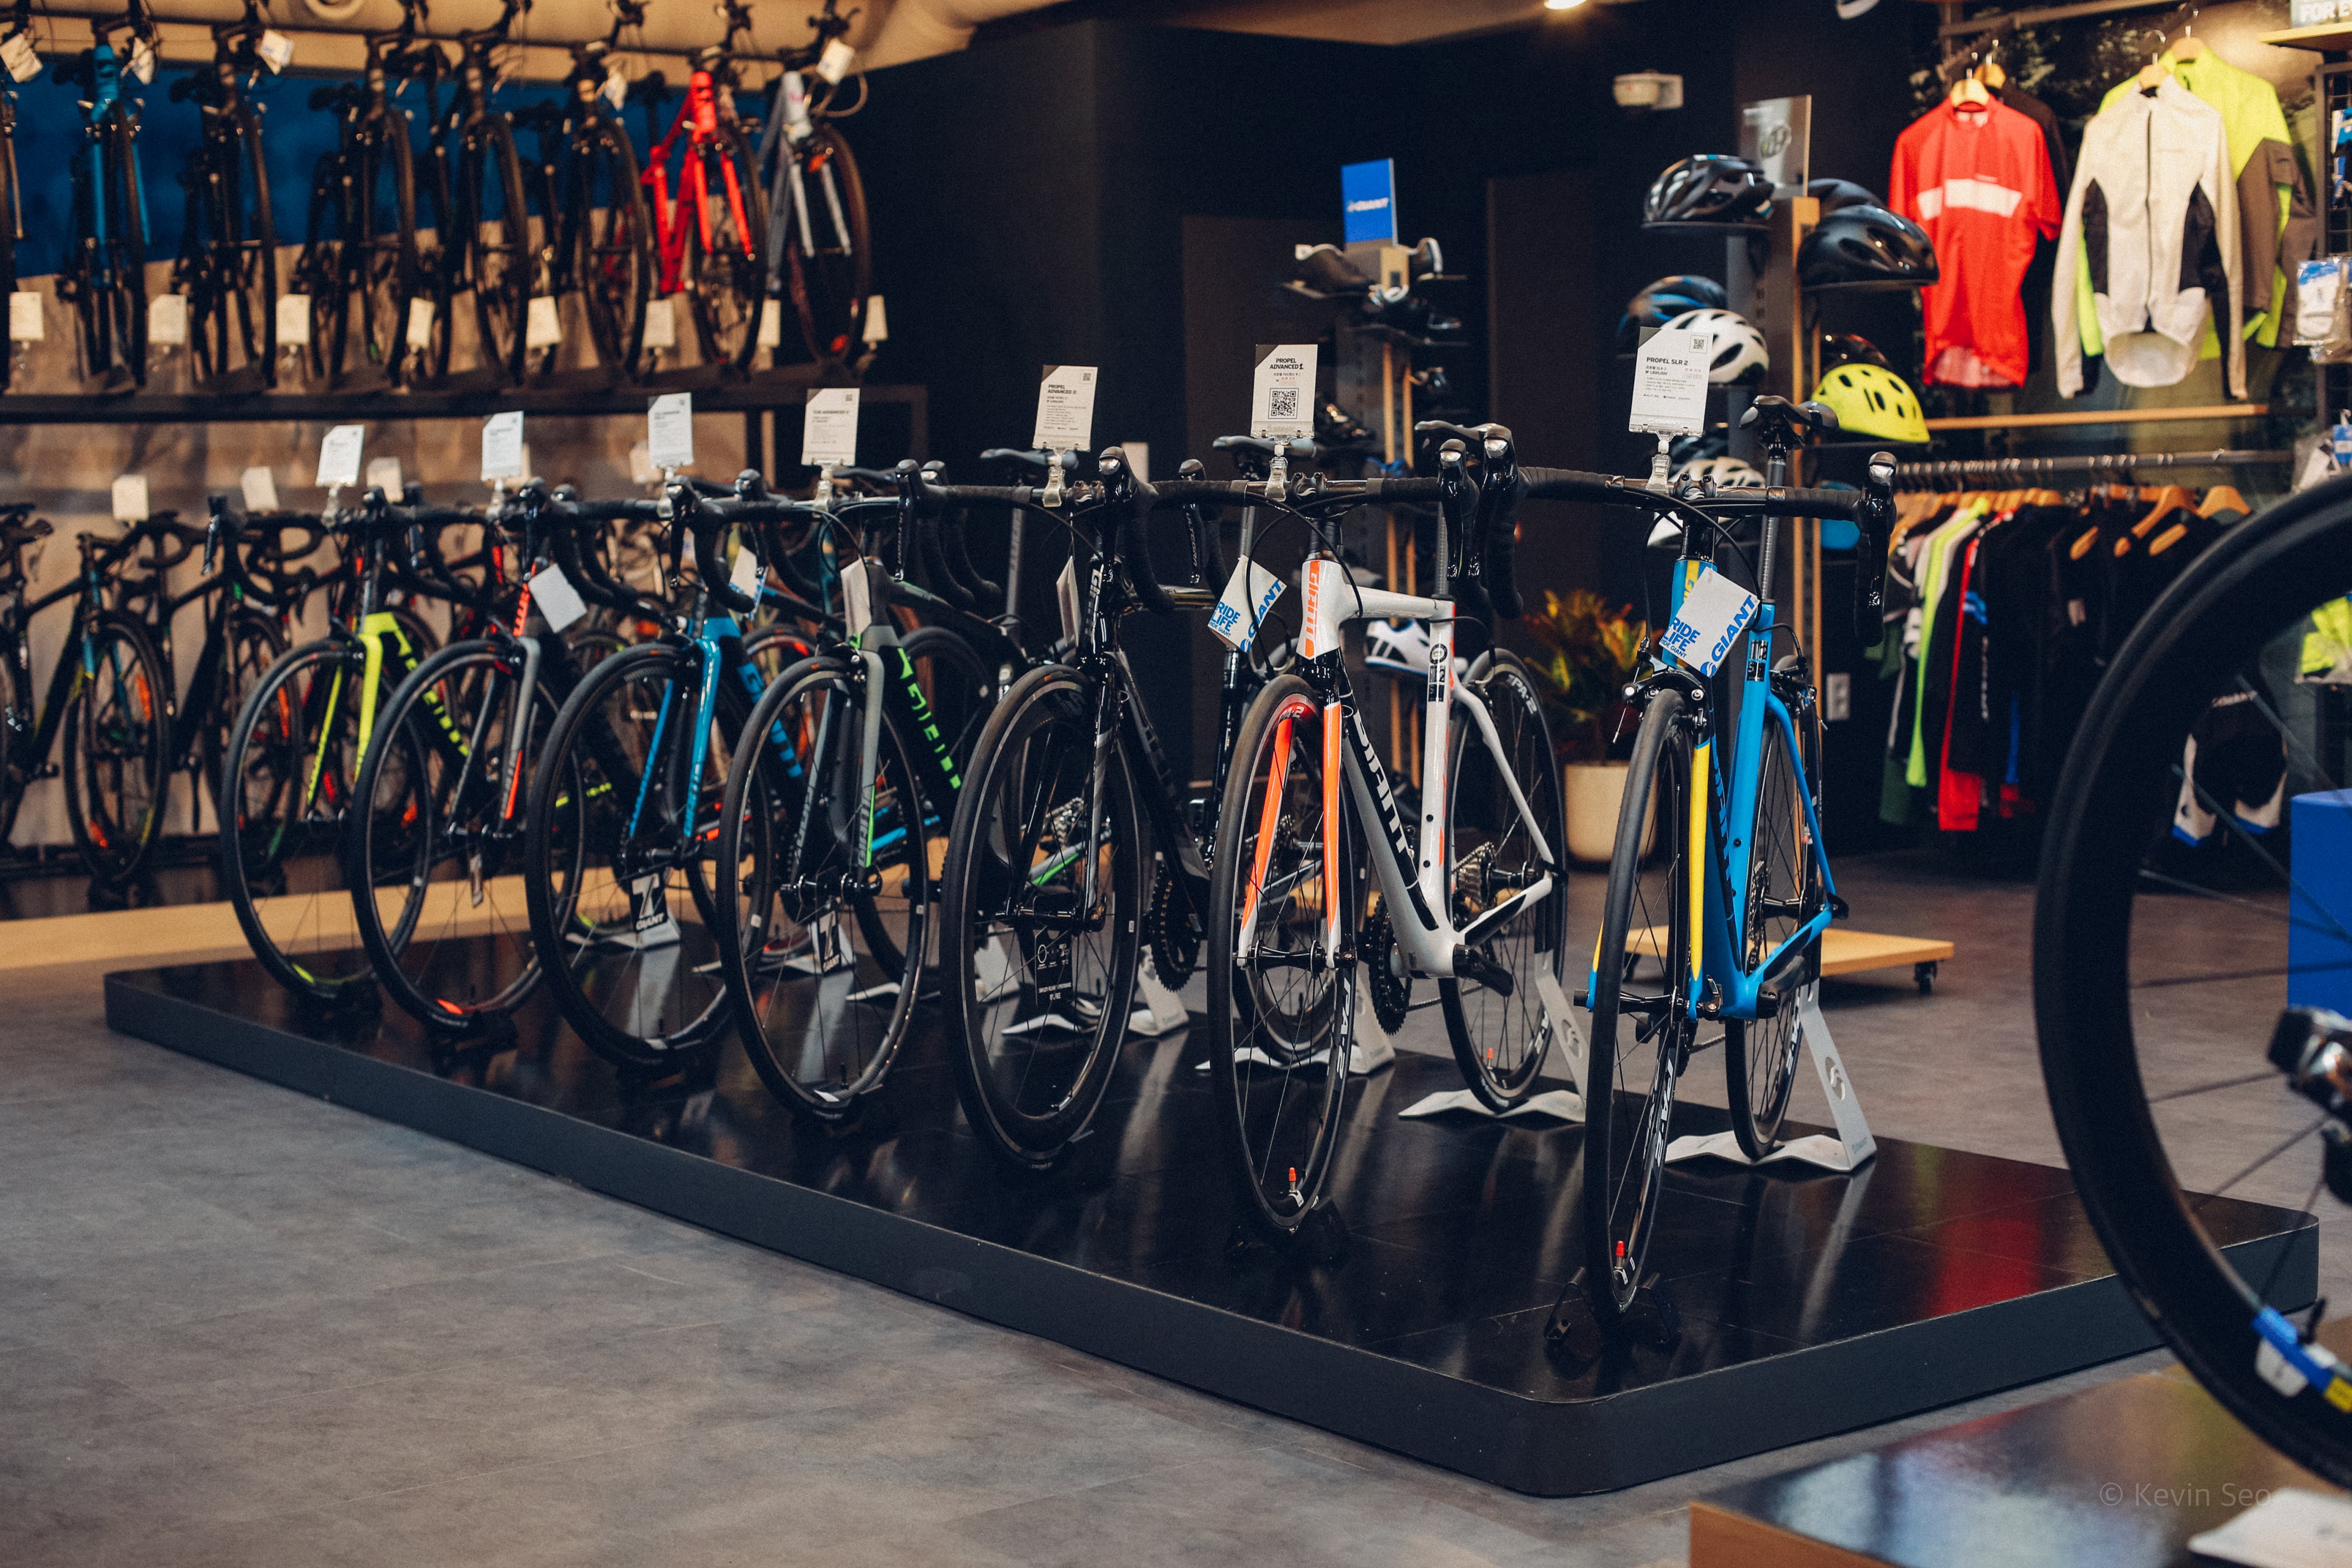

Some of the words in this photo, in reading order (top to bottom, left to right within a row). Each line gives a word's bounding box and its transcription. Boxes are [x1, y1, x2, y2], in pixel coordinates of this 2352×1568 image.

[1210, 611, 1234, 632] LIFE
[1215, 601, 1241, 624] RIDE
[1218, 627, 1231, 638] GIANT
[1663, 627, 1690, 652] LIFE
[1670, 617, 1700, 644] RIDE
[1711, 595, 1755, 662] GIANT
[1660, 638, 1670, 648] RIDE
[1670, 645, 1687, 658] GIANT
[636, 912, 665, 931] GIANT
